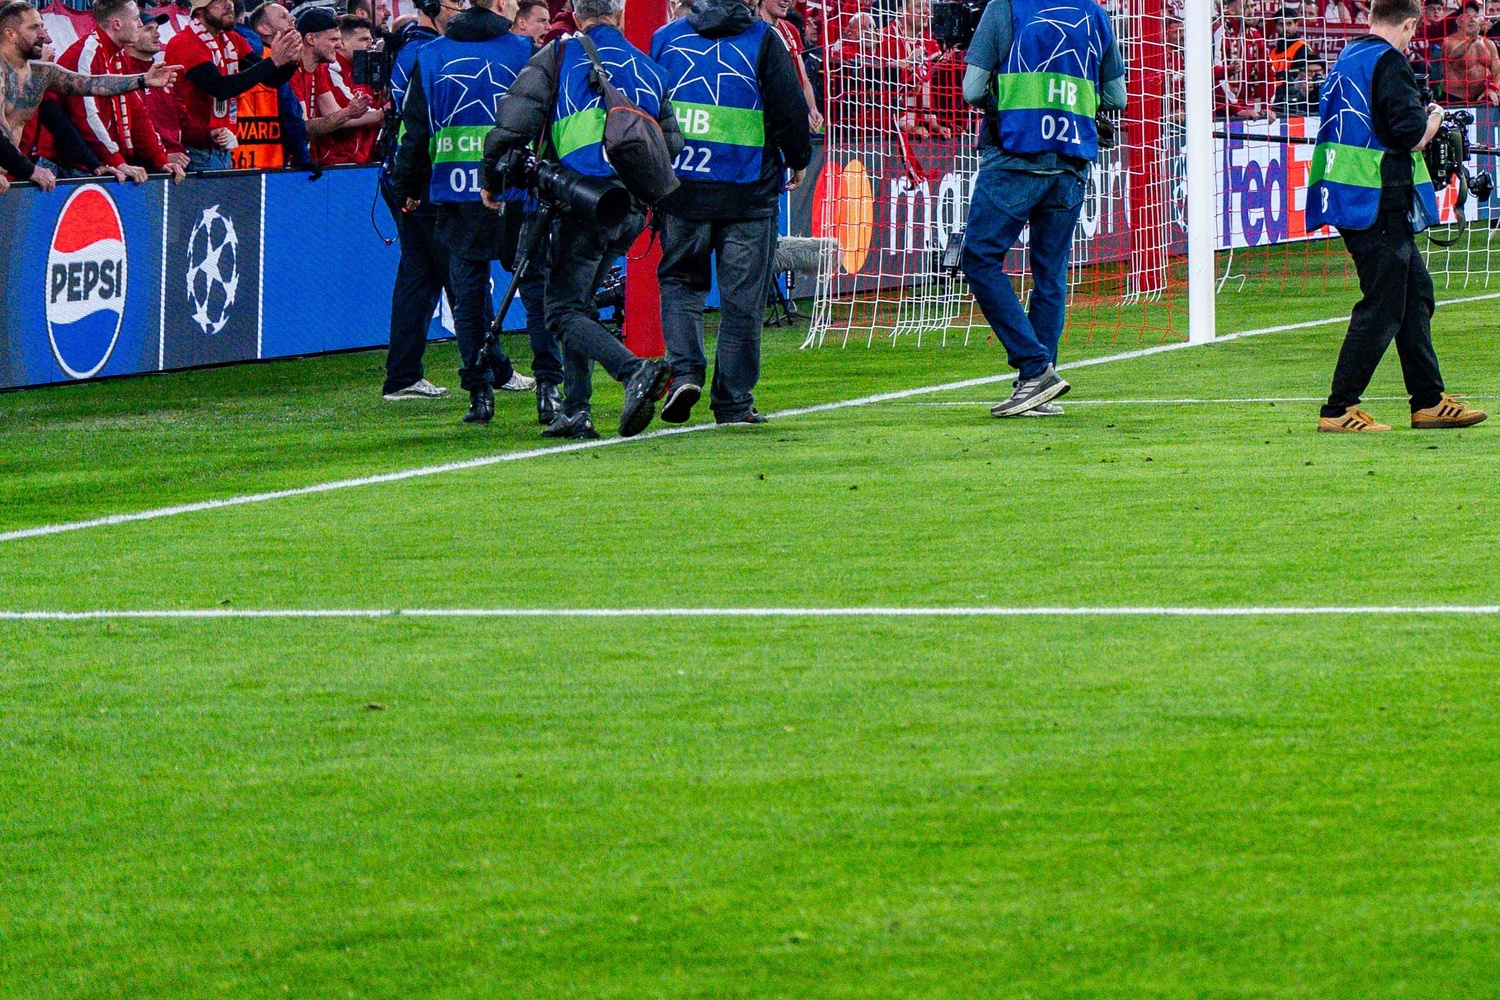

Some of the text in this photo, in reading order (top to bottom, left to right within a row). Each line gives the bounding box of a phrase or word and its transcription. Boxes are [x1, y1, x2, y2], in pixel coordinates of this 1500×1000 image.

[1048, 78, 1077, 106] HB
[675, 107, 710, 135] HB
[1041, 114, 1081, 145] 021
[50, 259, 123, 304] PEPSI
